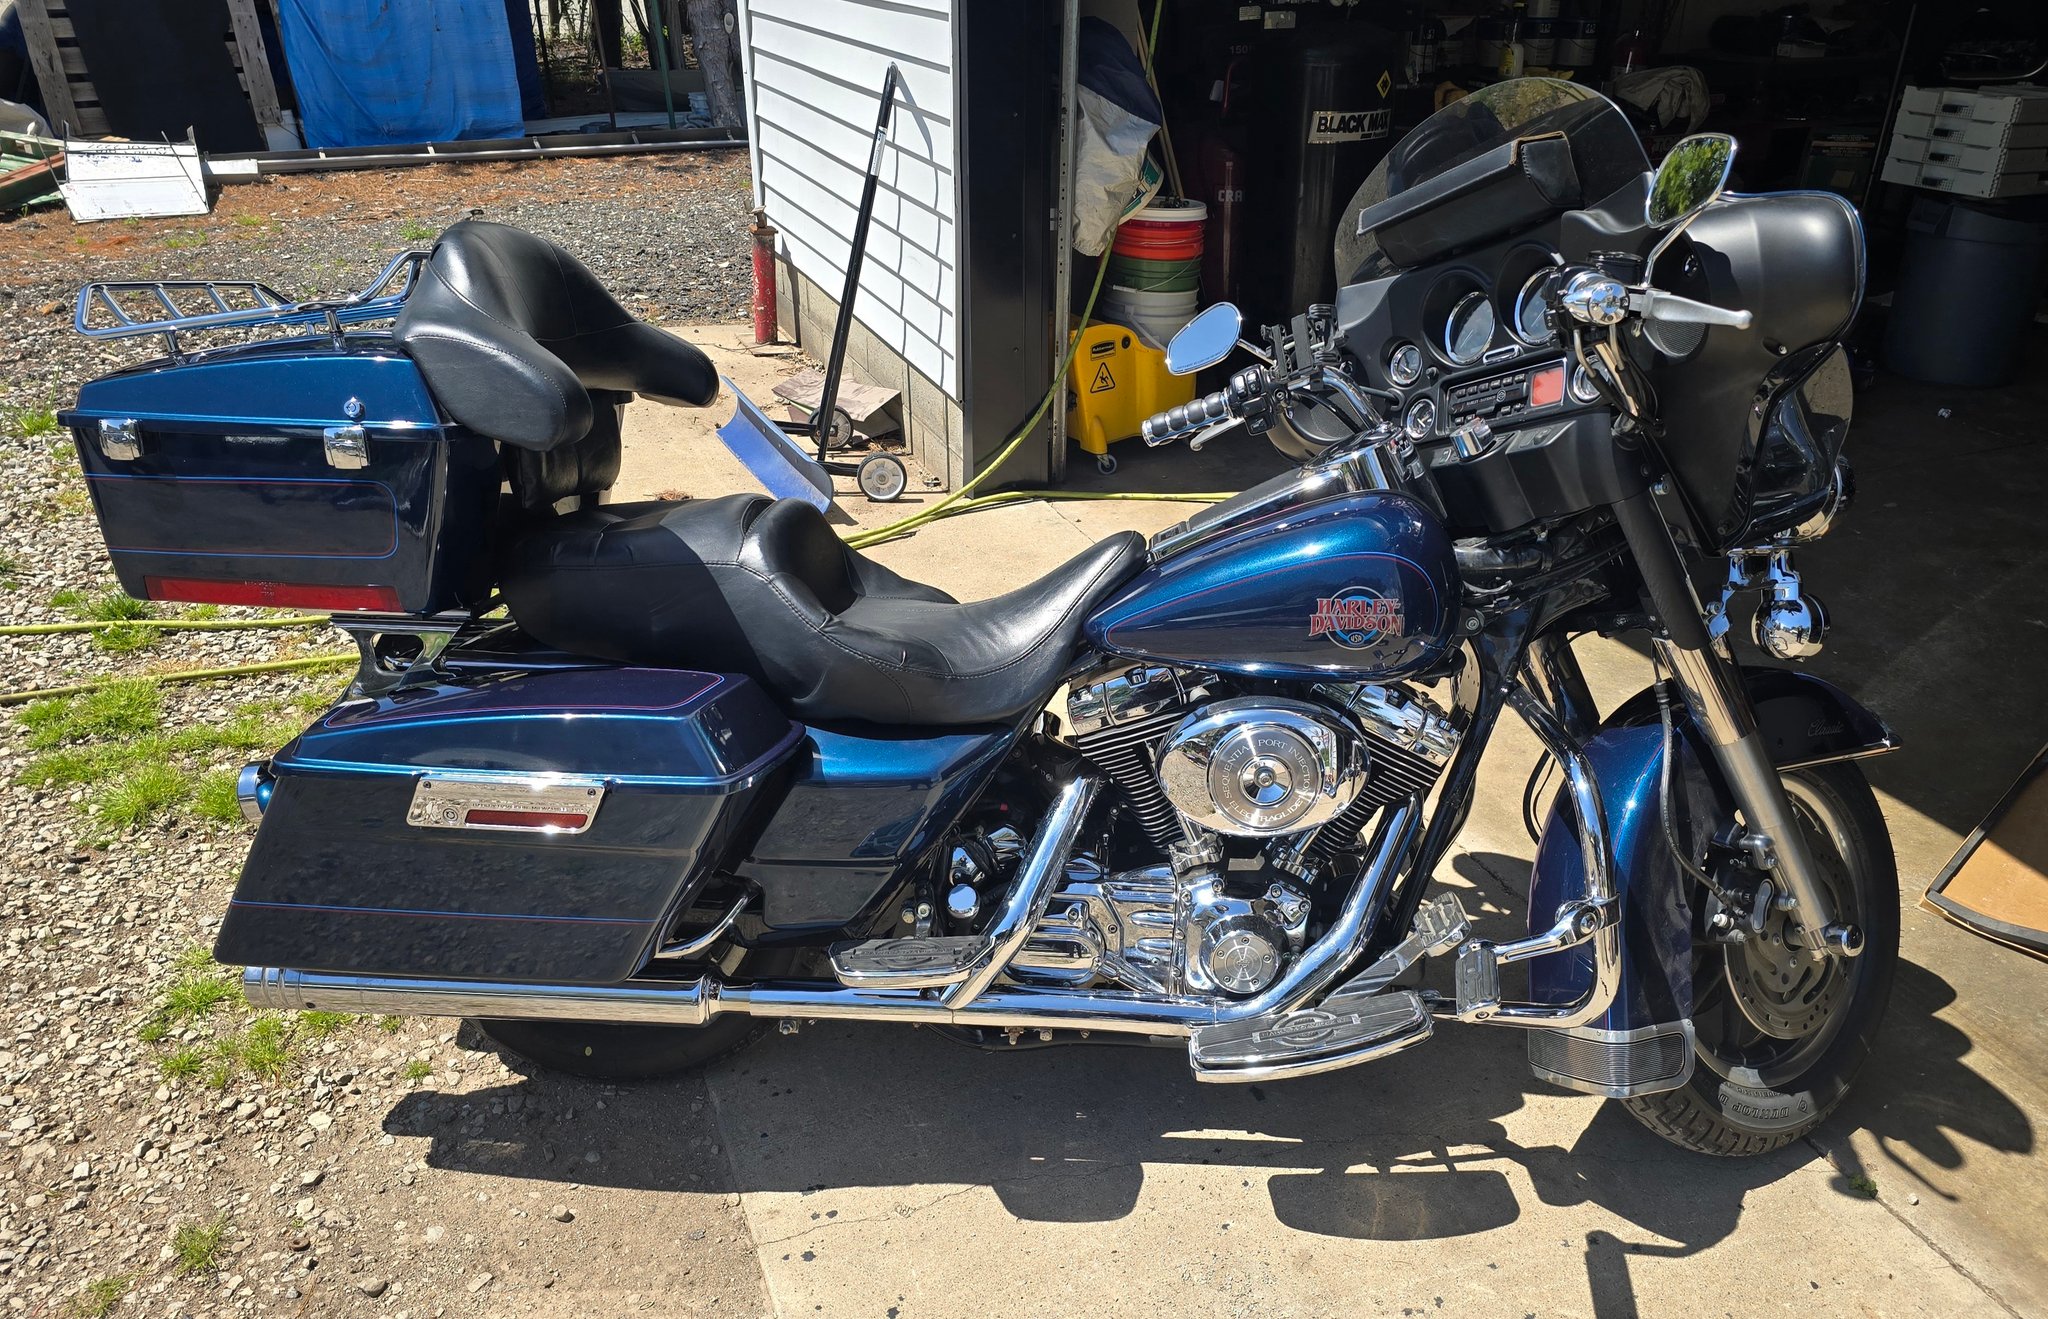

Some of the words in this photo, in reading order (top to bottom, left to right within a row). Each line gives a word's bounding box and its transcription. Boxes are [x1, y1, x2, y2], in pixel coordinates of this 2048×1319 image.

[1316, 113, 1368, 133] BLACK
[1367, 111, 1388, 132] MAX
[1308, 614, 1404, 637] DAVIDSON
[1258, 739, 1287, 749] PORT
[1731, 1102, 1790, 1120] DUNLOP
